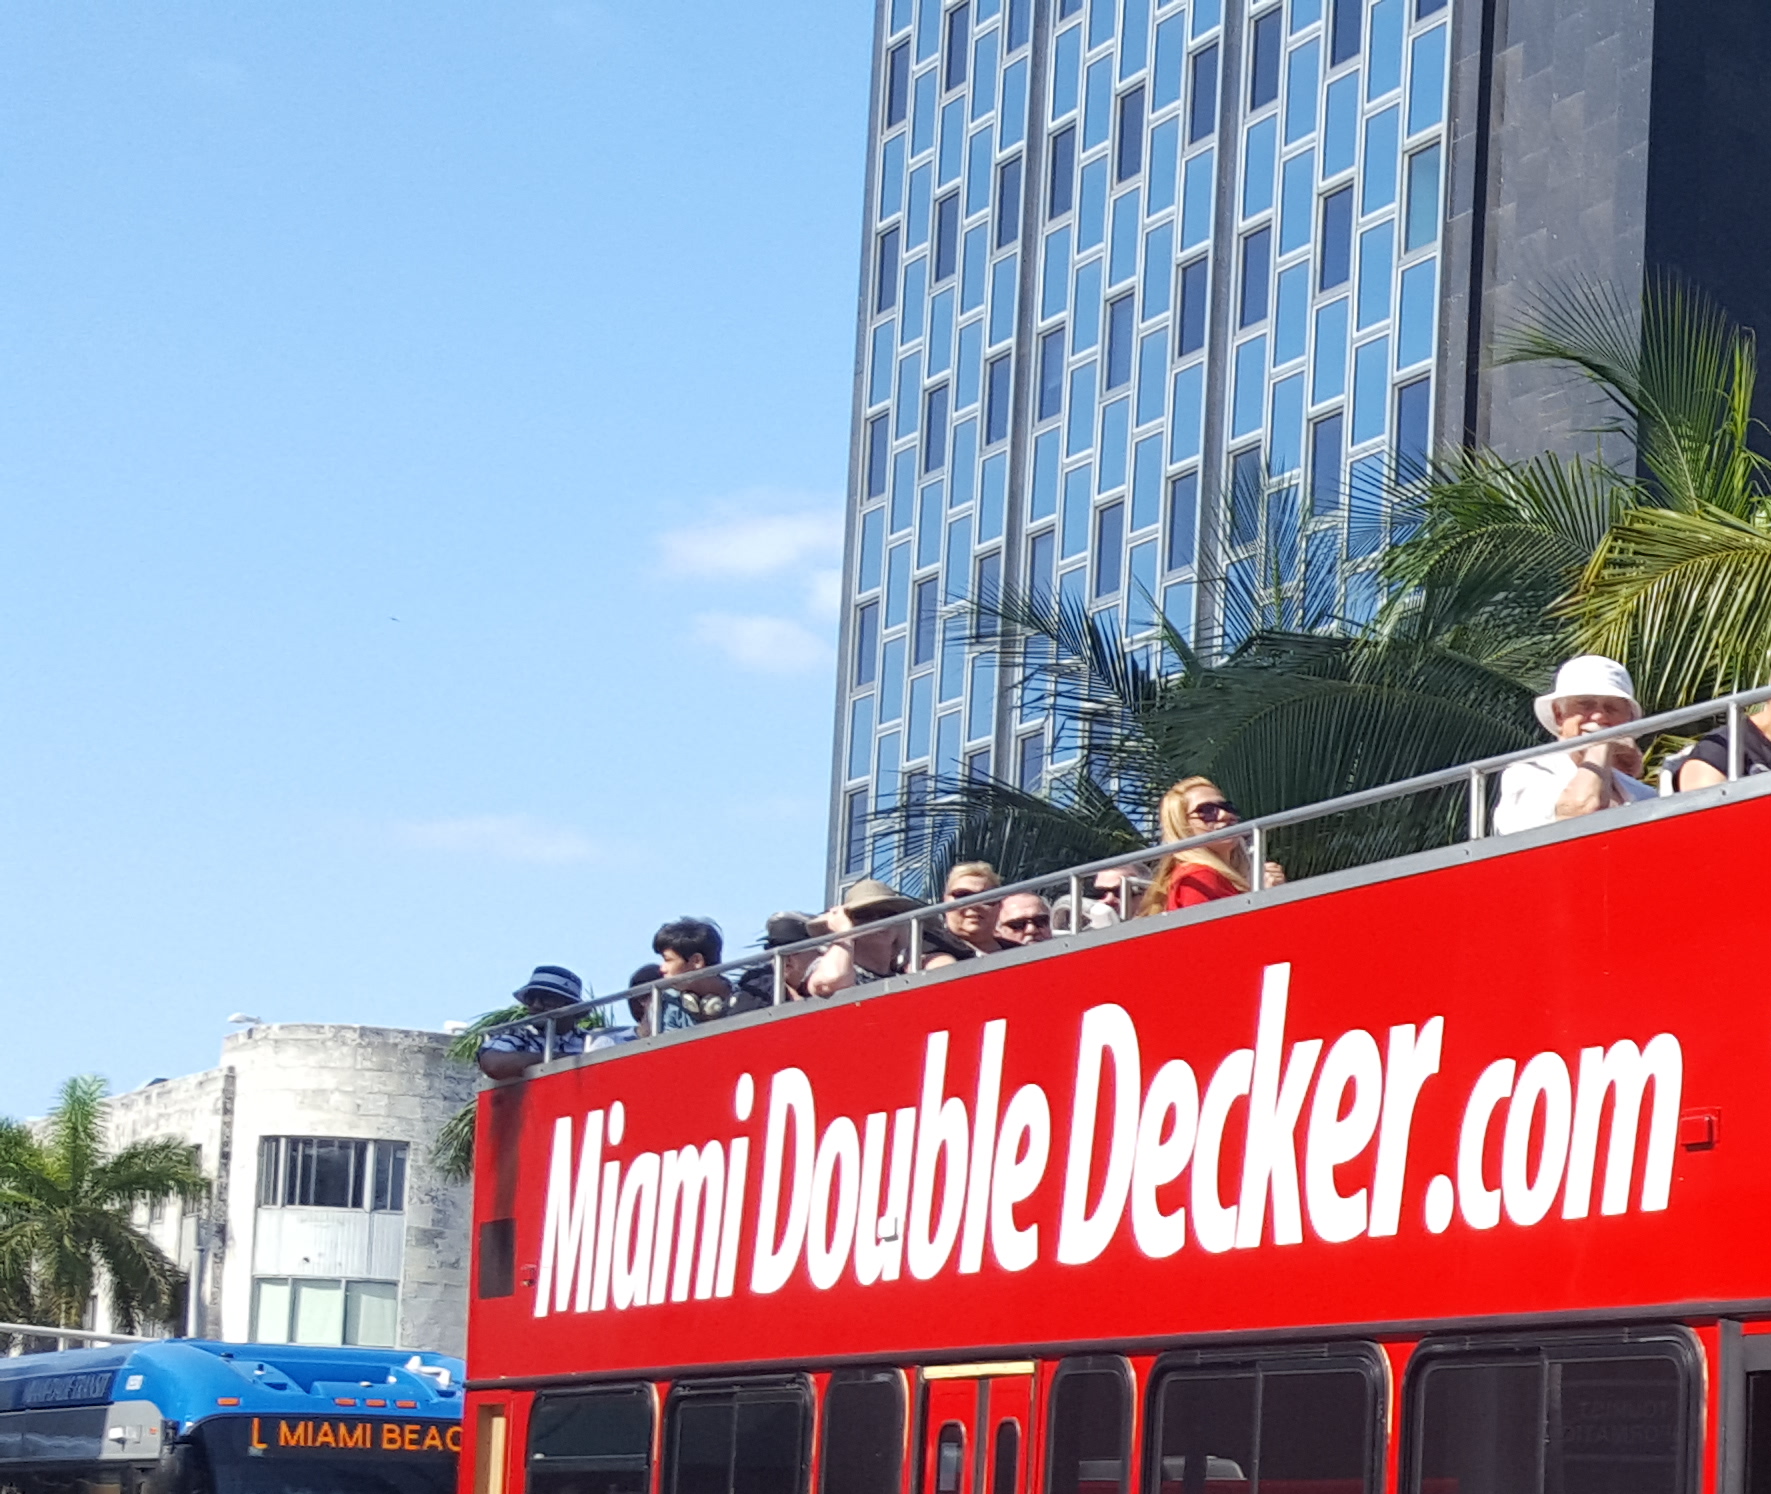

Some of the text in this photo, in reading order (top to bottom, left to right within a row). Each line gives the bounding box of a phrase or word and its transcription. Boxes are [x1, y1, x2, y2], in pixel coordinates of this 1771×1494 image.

[251, 1417, 463, 1451] L MIAMI BEAC
